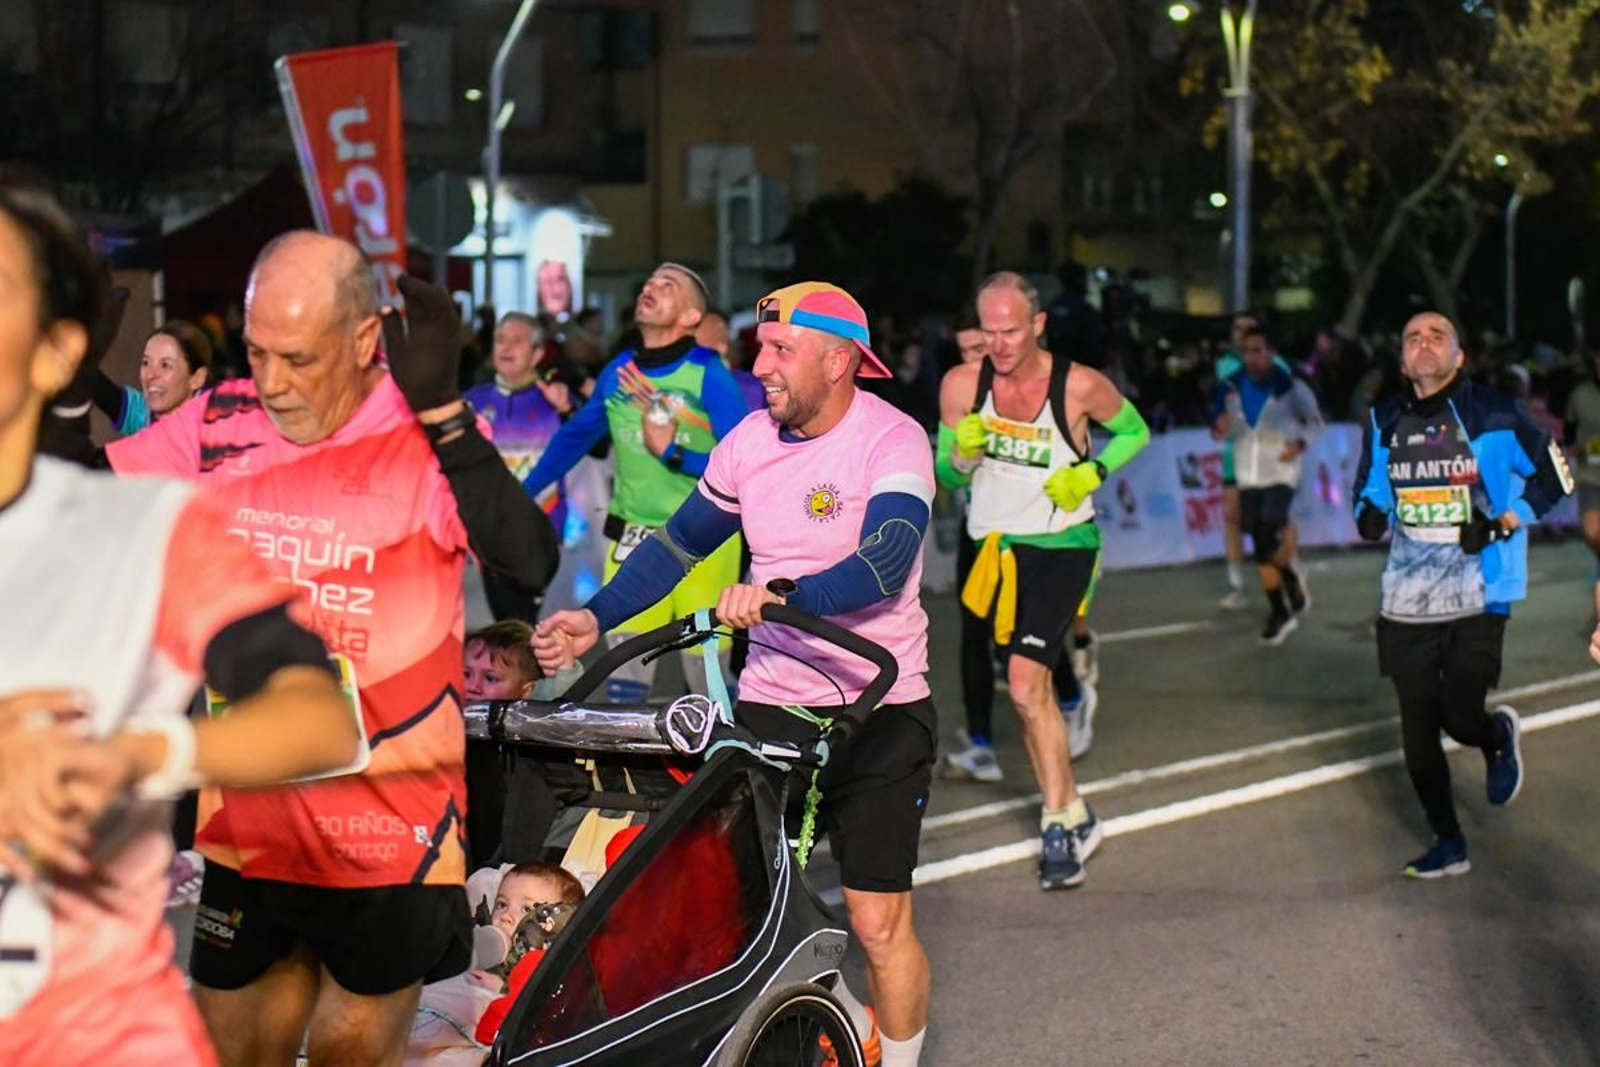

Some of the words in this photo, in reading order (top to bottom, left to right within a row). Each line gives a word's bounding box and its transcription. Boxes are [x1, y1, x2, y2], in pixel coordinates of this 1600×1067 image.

[984, 433, 1046, 463] 1387
[1416, 454, 1478, 480] ANTÓN
[1402, 502, 1465, 523] 2122
[226, 527, 376, 582] aquín
[348, 810, 407, 836] AÑOS
